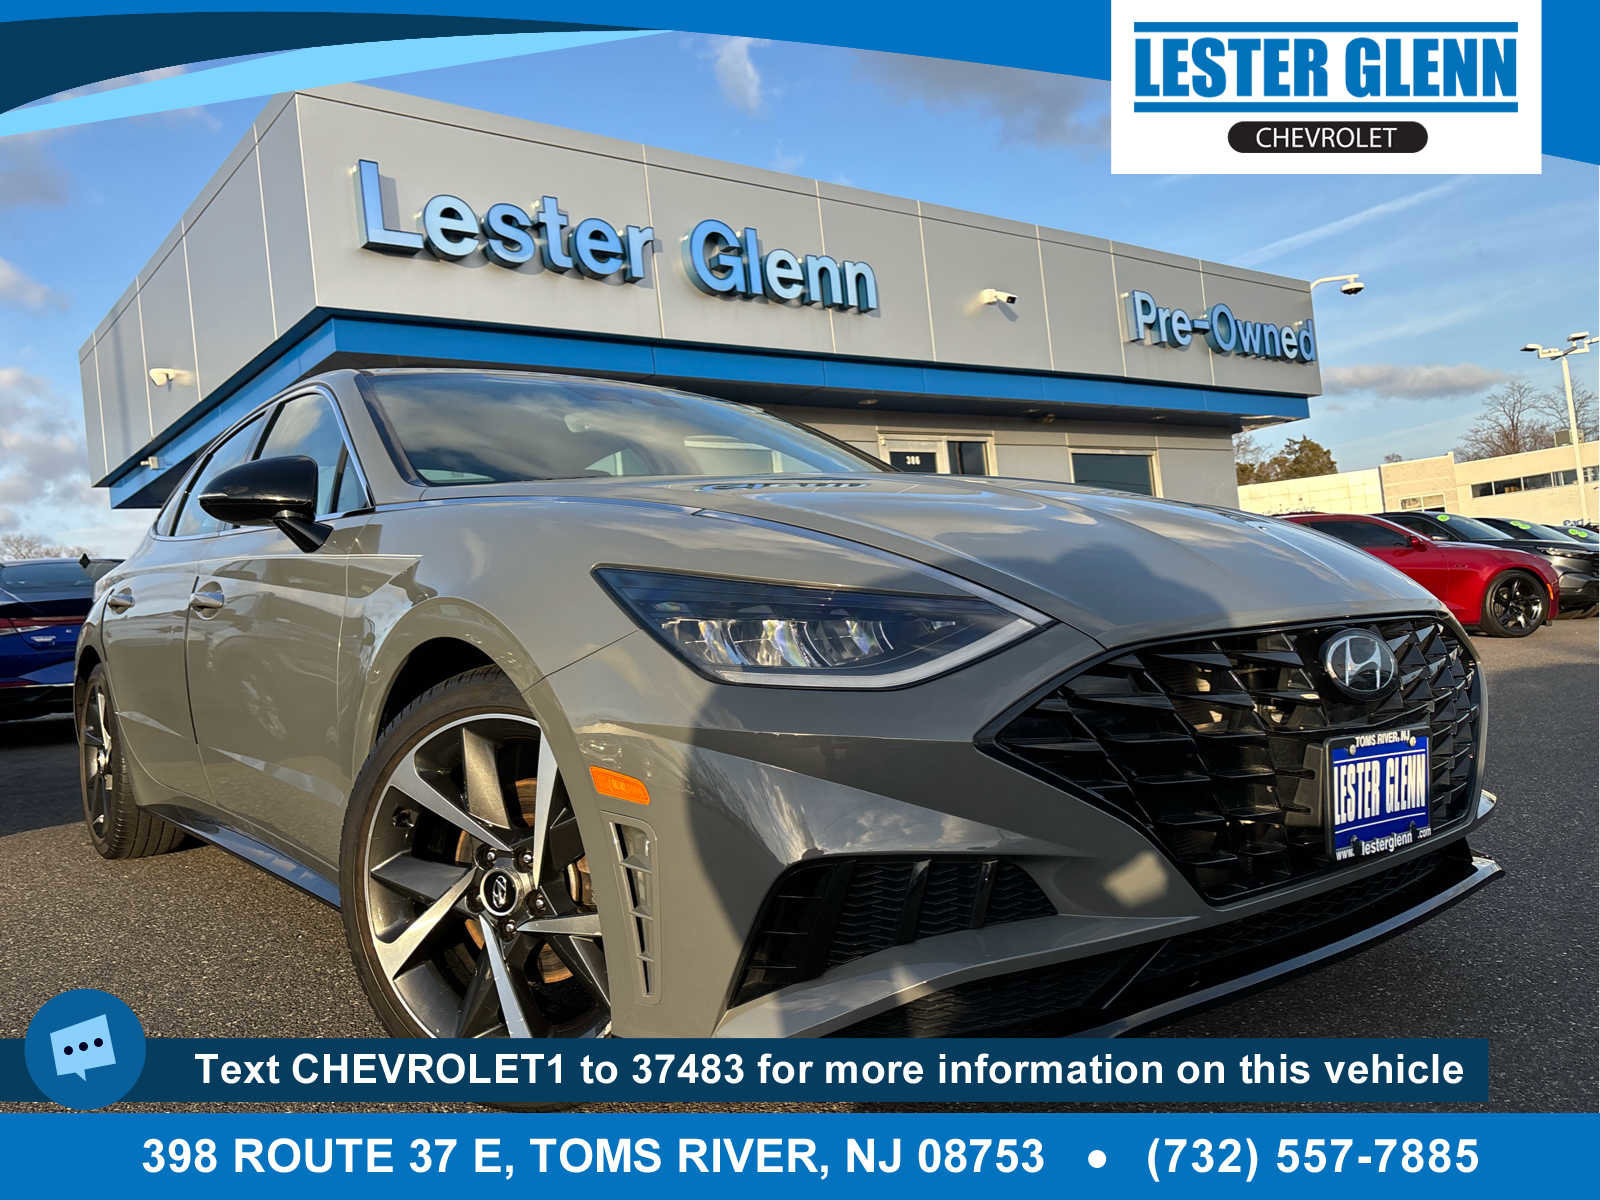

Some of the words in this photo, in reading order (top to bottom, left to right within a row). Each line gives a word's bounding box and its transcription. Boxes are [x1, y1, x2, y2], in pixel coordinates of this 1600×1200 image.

[357, 158, 655, 283] Lester
[684, 218, 879, 314] Glenn
[1129, 289, 1317, 364] Pre-Owned
[1355, 734, 1376, 748] TOMS
[1400, 729, 1410, 743] NJ
[1333, 760, 1381, 826] LESTER
[1386, 754, 1426, 814] GLENN
[1361, 832, 1413, 856] lesterglenn
[1417, 827, 1432, 840] .com
